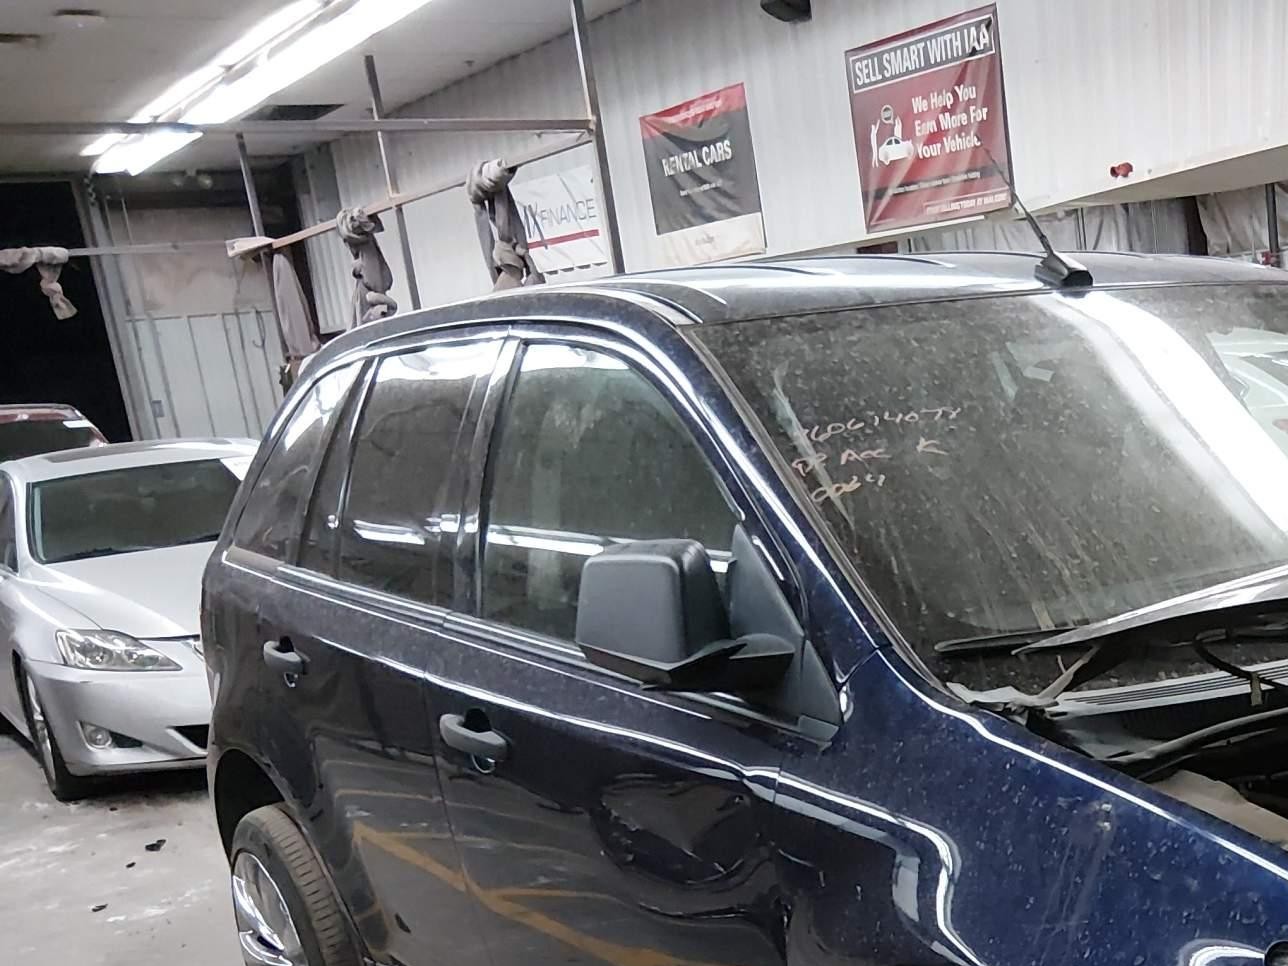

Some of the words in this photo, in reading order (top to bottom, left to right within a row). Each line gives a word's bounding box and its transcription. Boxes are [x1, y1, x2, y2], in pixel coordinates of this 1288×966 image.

[855, 57, 882, 86] SELL
[882, 43, 926, 77] SMART
[926, 29, 962, 64] WITH
[963, 22, 990, 53] IAA
[911, 95, 929, 114] We
[929, 89, 954, 110] Help
[954, 84, 977, 103] You
[914, 119, 938, 137] Earn
[938, 110, 968, 131] More
[969, 105, 989, 124] For
[661, 151, 703, 177] RENTAL
[701, 139, 732, 166] CARS
[916, 142, 943, 160] Your
[942, 132, 982, 154] Vehicle
